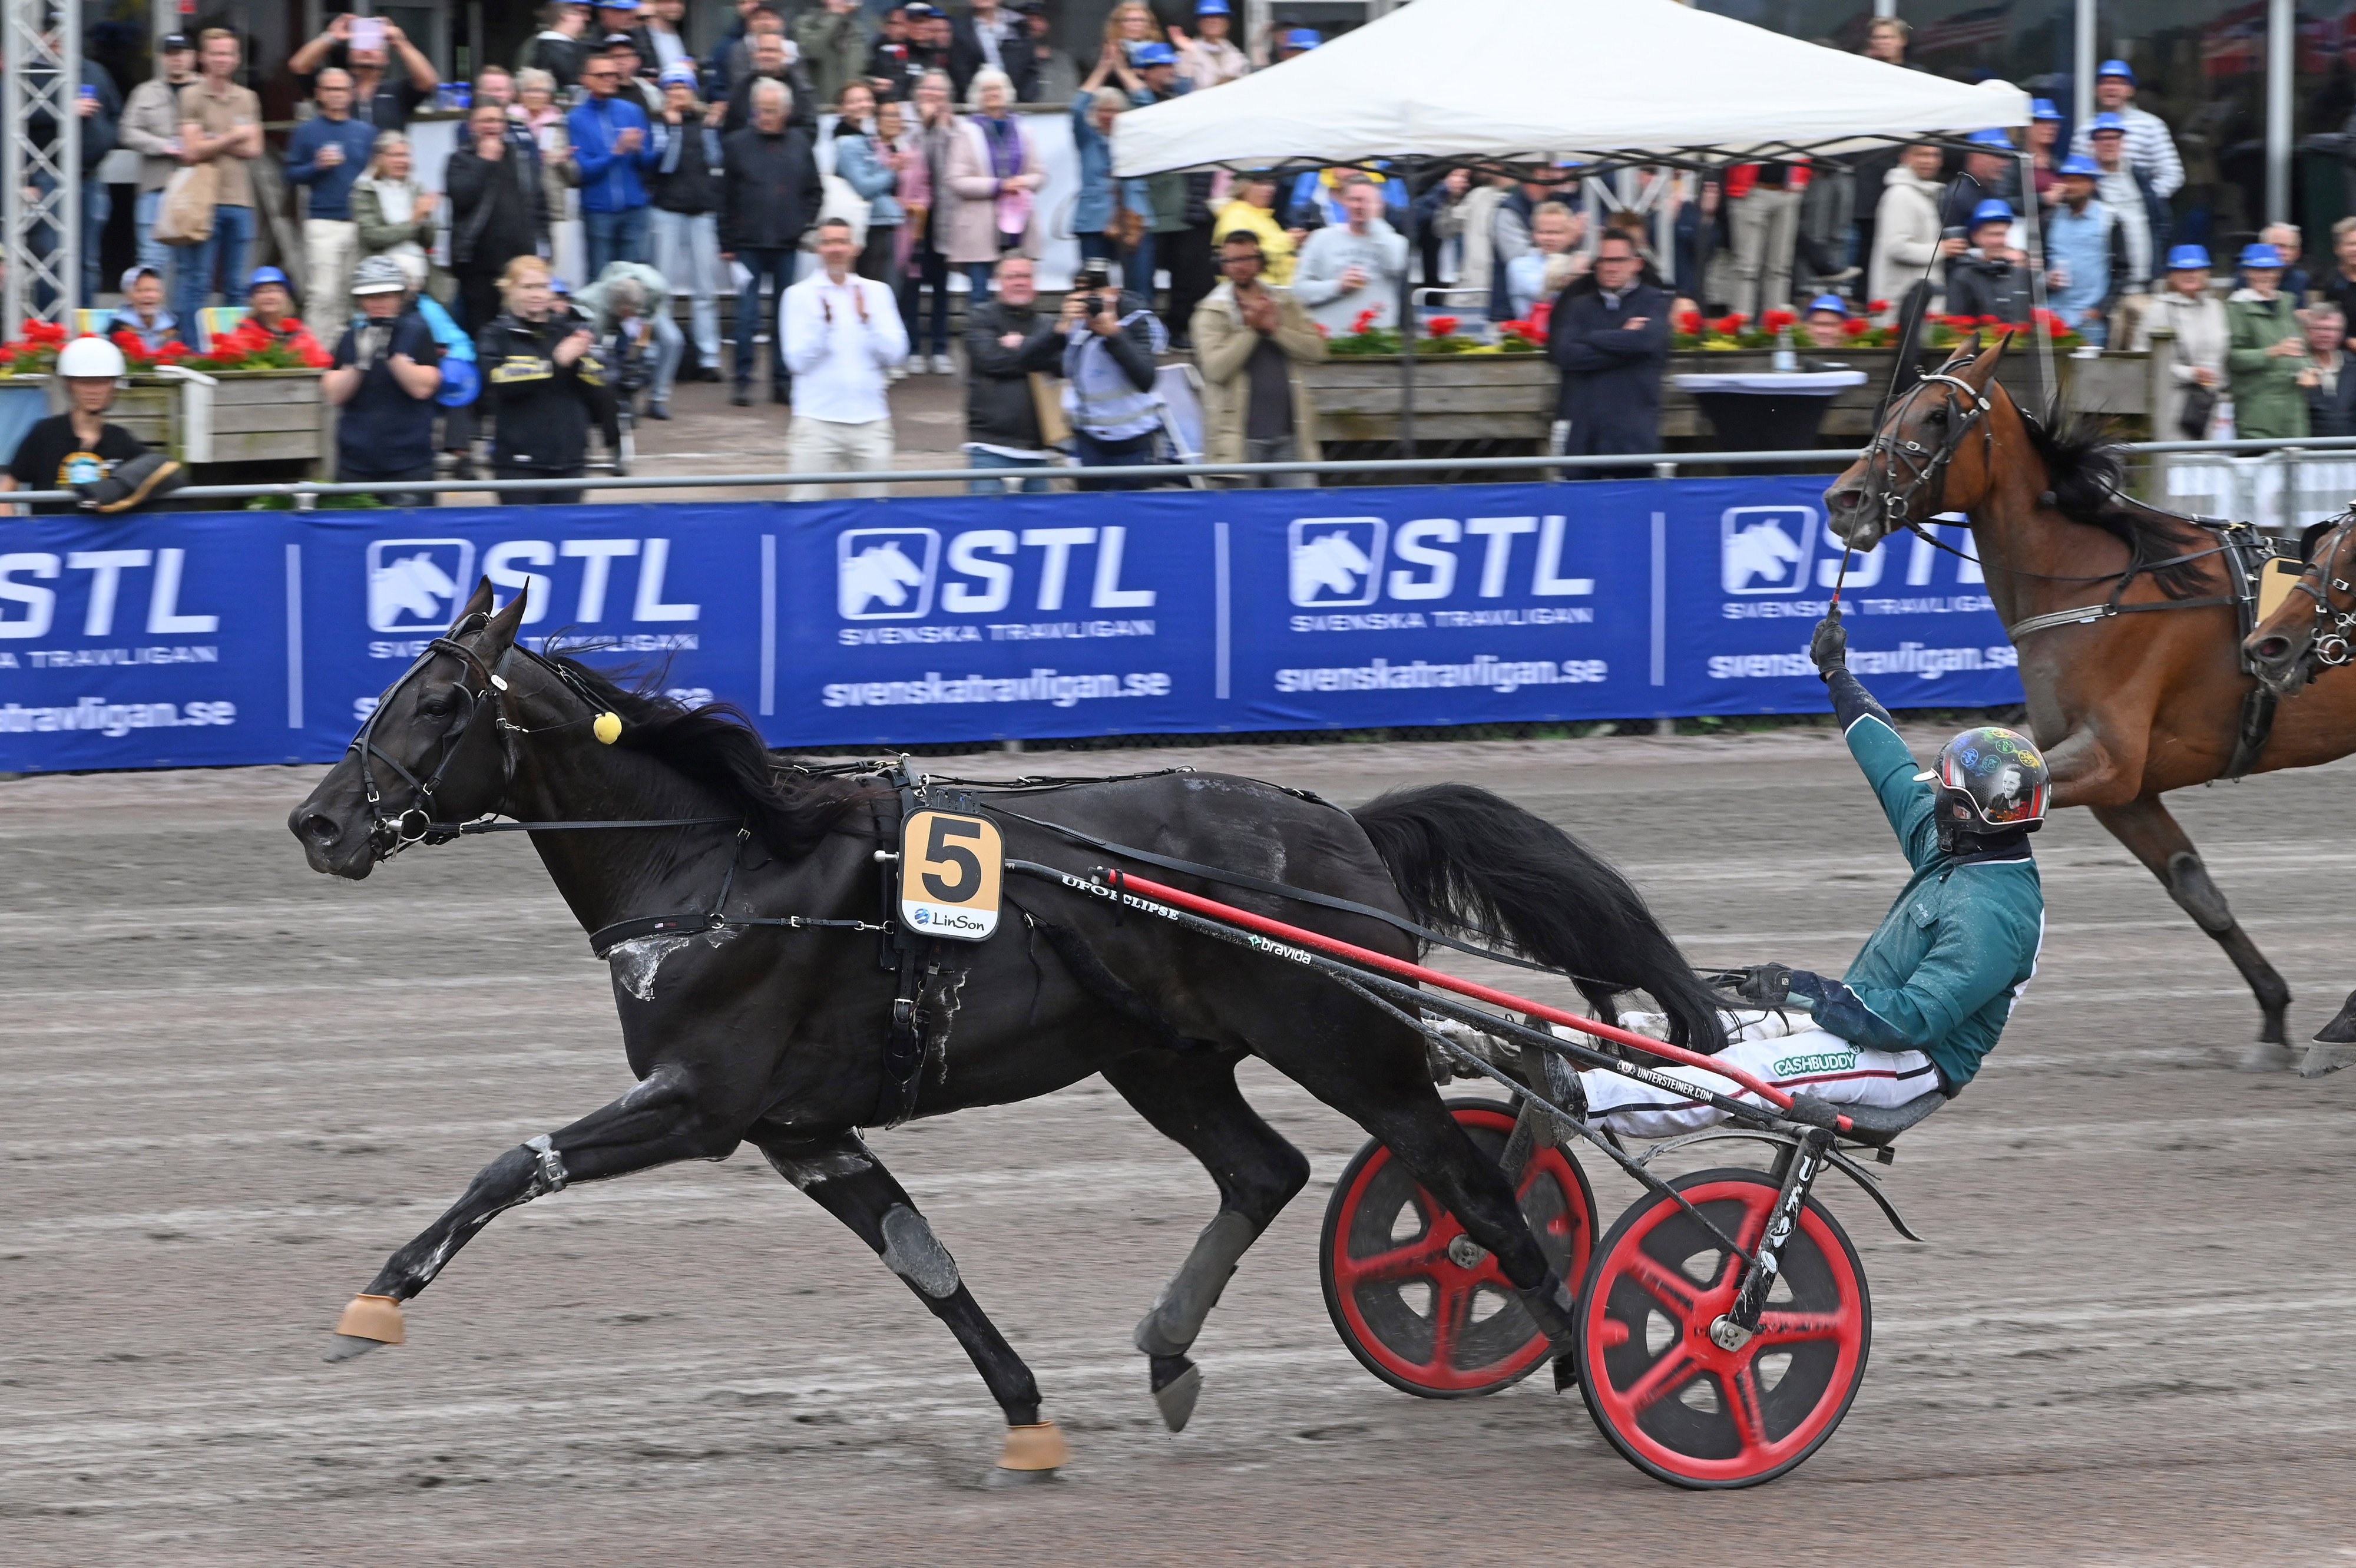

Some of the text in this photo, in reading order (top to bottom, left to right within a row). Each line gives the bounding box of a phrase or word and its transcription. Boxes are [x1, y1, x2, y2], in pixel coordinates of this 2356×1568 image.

[941, 526, 1156, 613] STL
[1387, 515, 1595, 600] STL
[0, 548, 219, 639] STL
[482, 538, 701, 624] STL
[1289, 607, 1594, 632] SVENSKA TRAVLIGAN
[1858, 595, 1996, 614] TRAVLIGA
[838, 620, 1156, 645] SVENSKA TRAVLIGAN
[822, 668, 1172, 707] svenskatravligan.se
[1274, 654, 1608, 693] svenskatravligan.se
[0, 696, 236, 737] travligan.se
[921, 816, 982, 903] 5
[932, 912, 985, 931] LinSon
[1260, 937, 1312, 965] bravida
[1774, 1051, 1857, 1077] CASHBUDDY
[1637, 1067, 1713, 1103] UNTERSTEINER.COM
